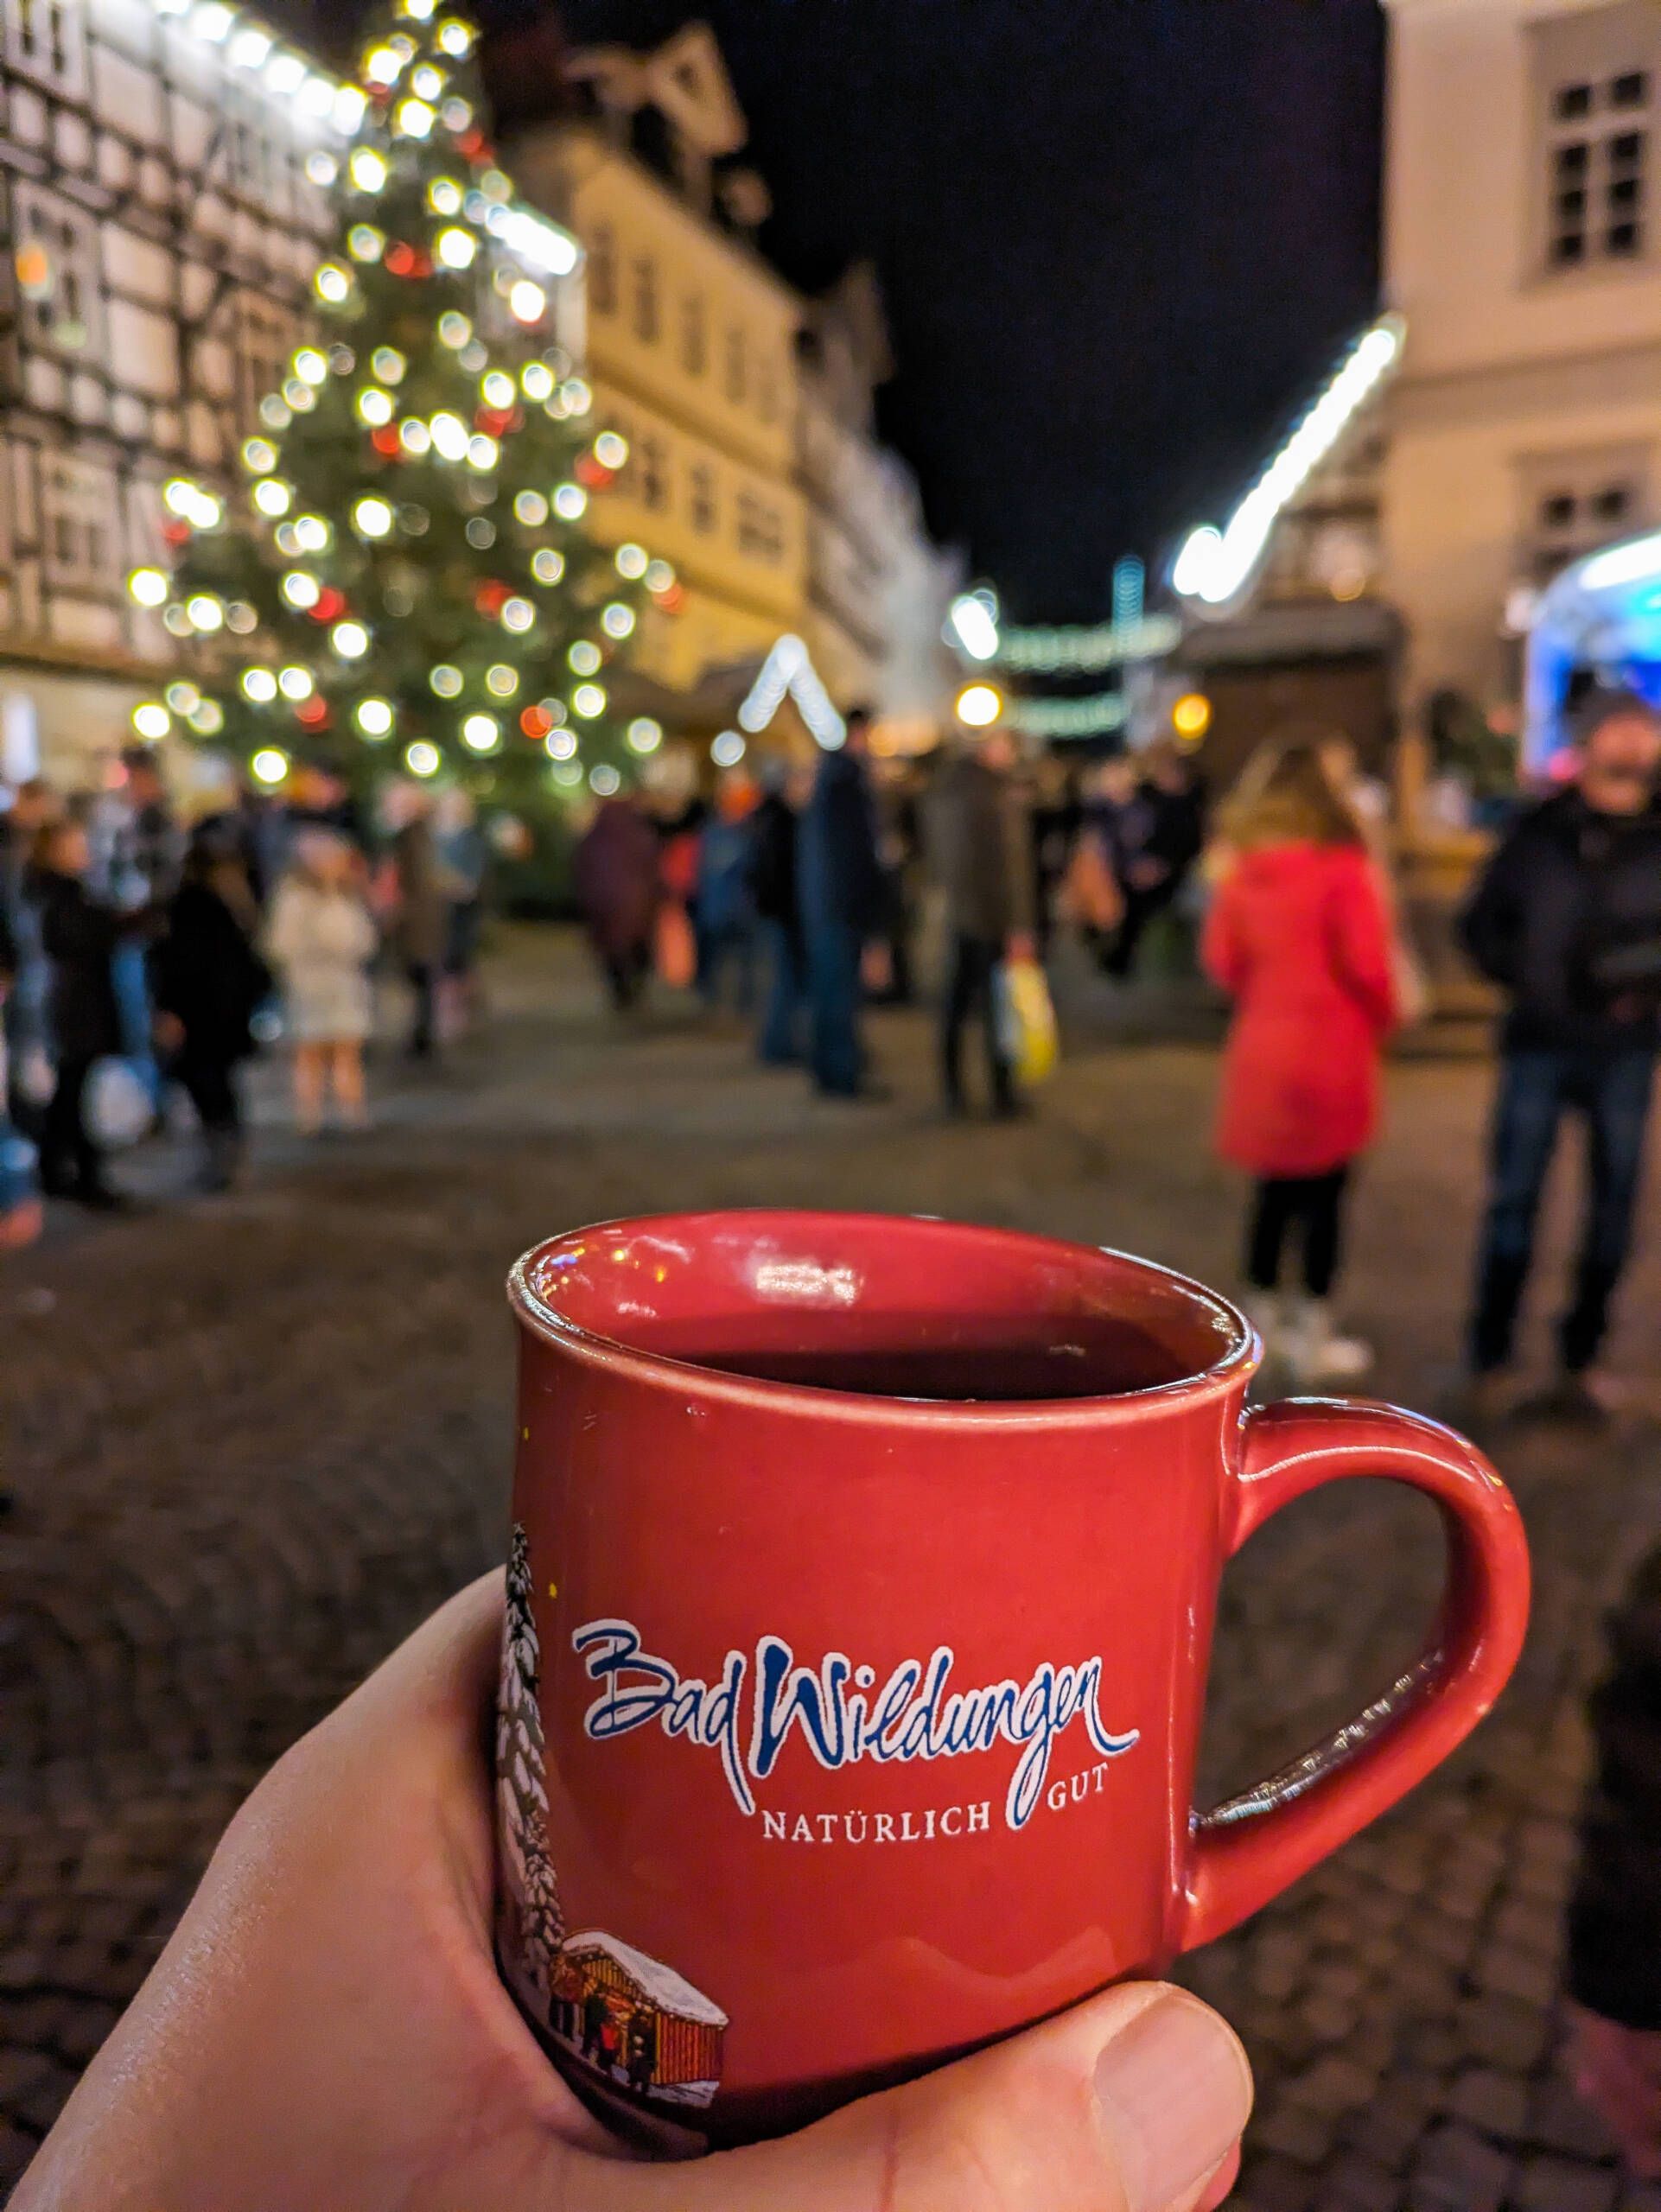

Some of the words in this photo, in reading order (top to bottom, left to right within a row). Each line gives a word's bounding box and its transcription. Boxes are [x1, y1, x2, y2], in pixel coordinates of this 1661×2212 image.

[571, 1618, 756, 1816] Bad
[751, 1635, 1141, 1831] Wildungen
[761, 1801, 991, 1844] NATÜRLICH
[1046, 1763, 1109, 1812] GUT
